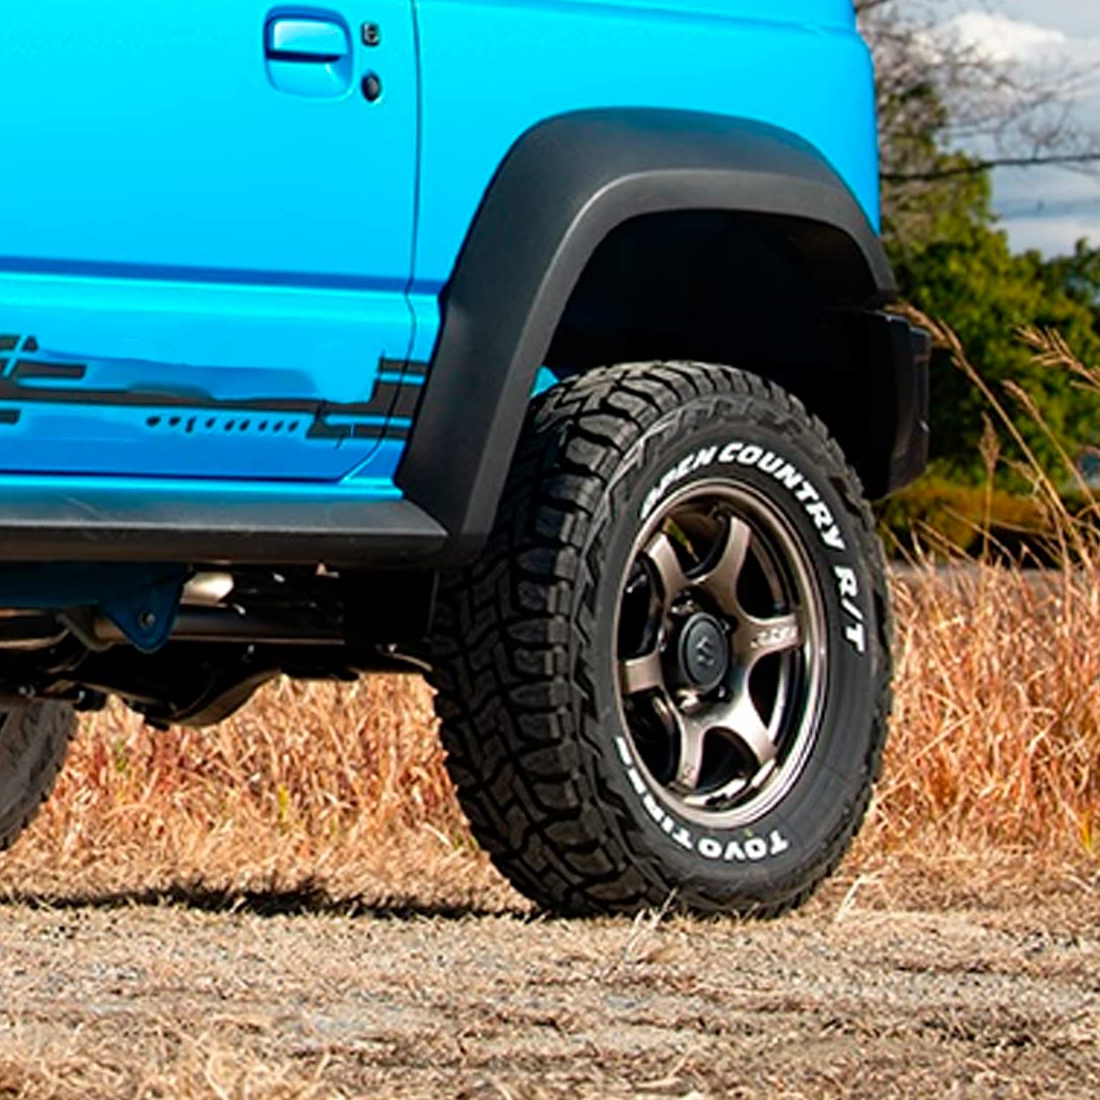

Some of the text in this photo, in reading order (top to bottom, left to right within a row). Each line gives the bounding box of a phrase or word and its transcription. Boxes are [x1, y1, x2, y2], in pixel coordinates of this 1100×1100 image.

[718, 442, 846, 550] COUNTRY
[834, 565, 866, 652] R/T
[697, 829, 789, 861] TOYO
